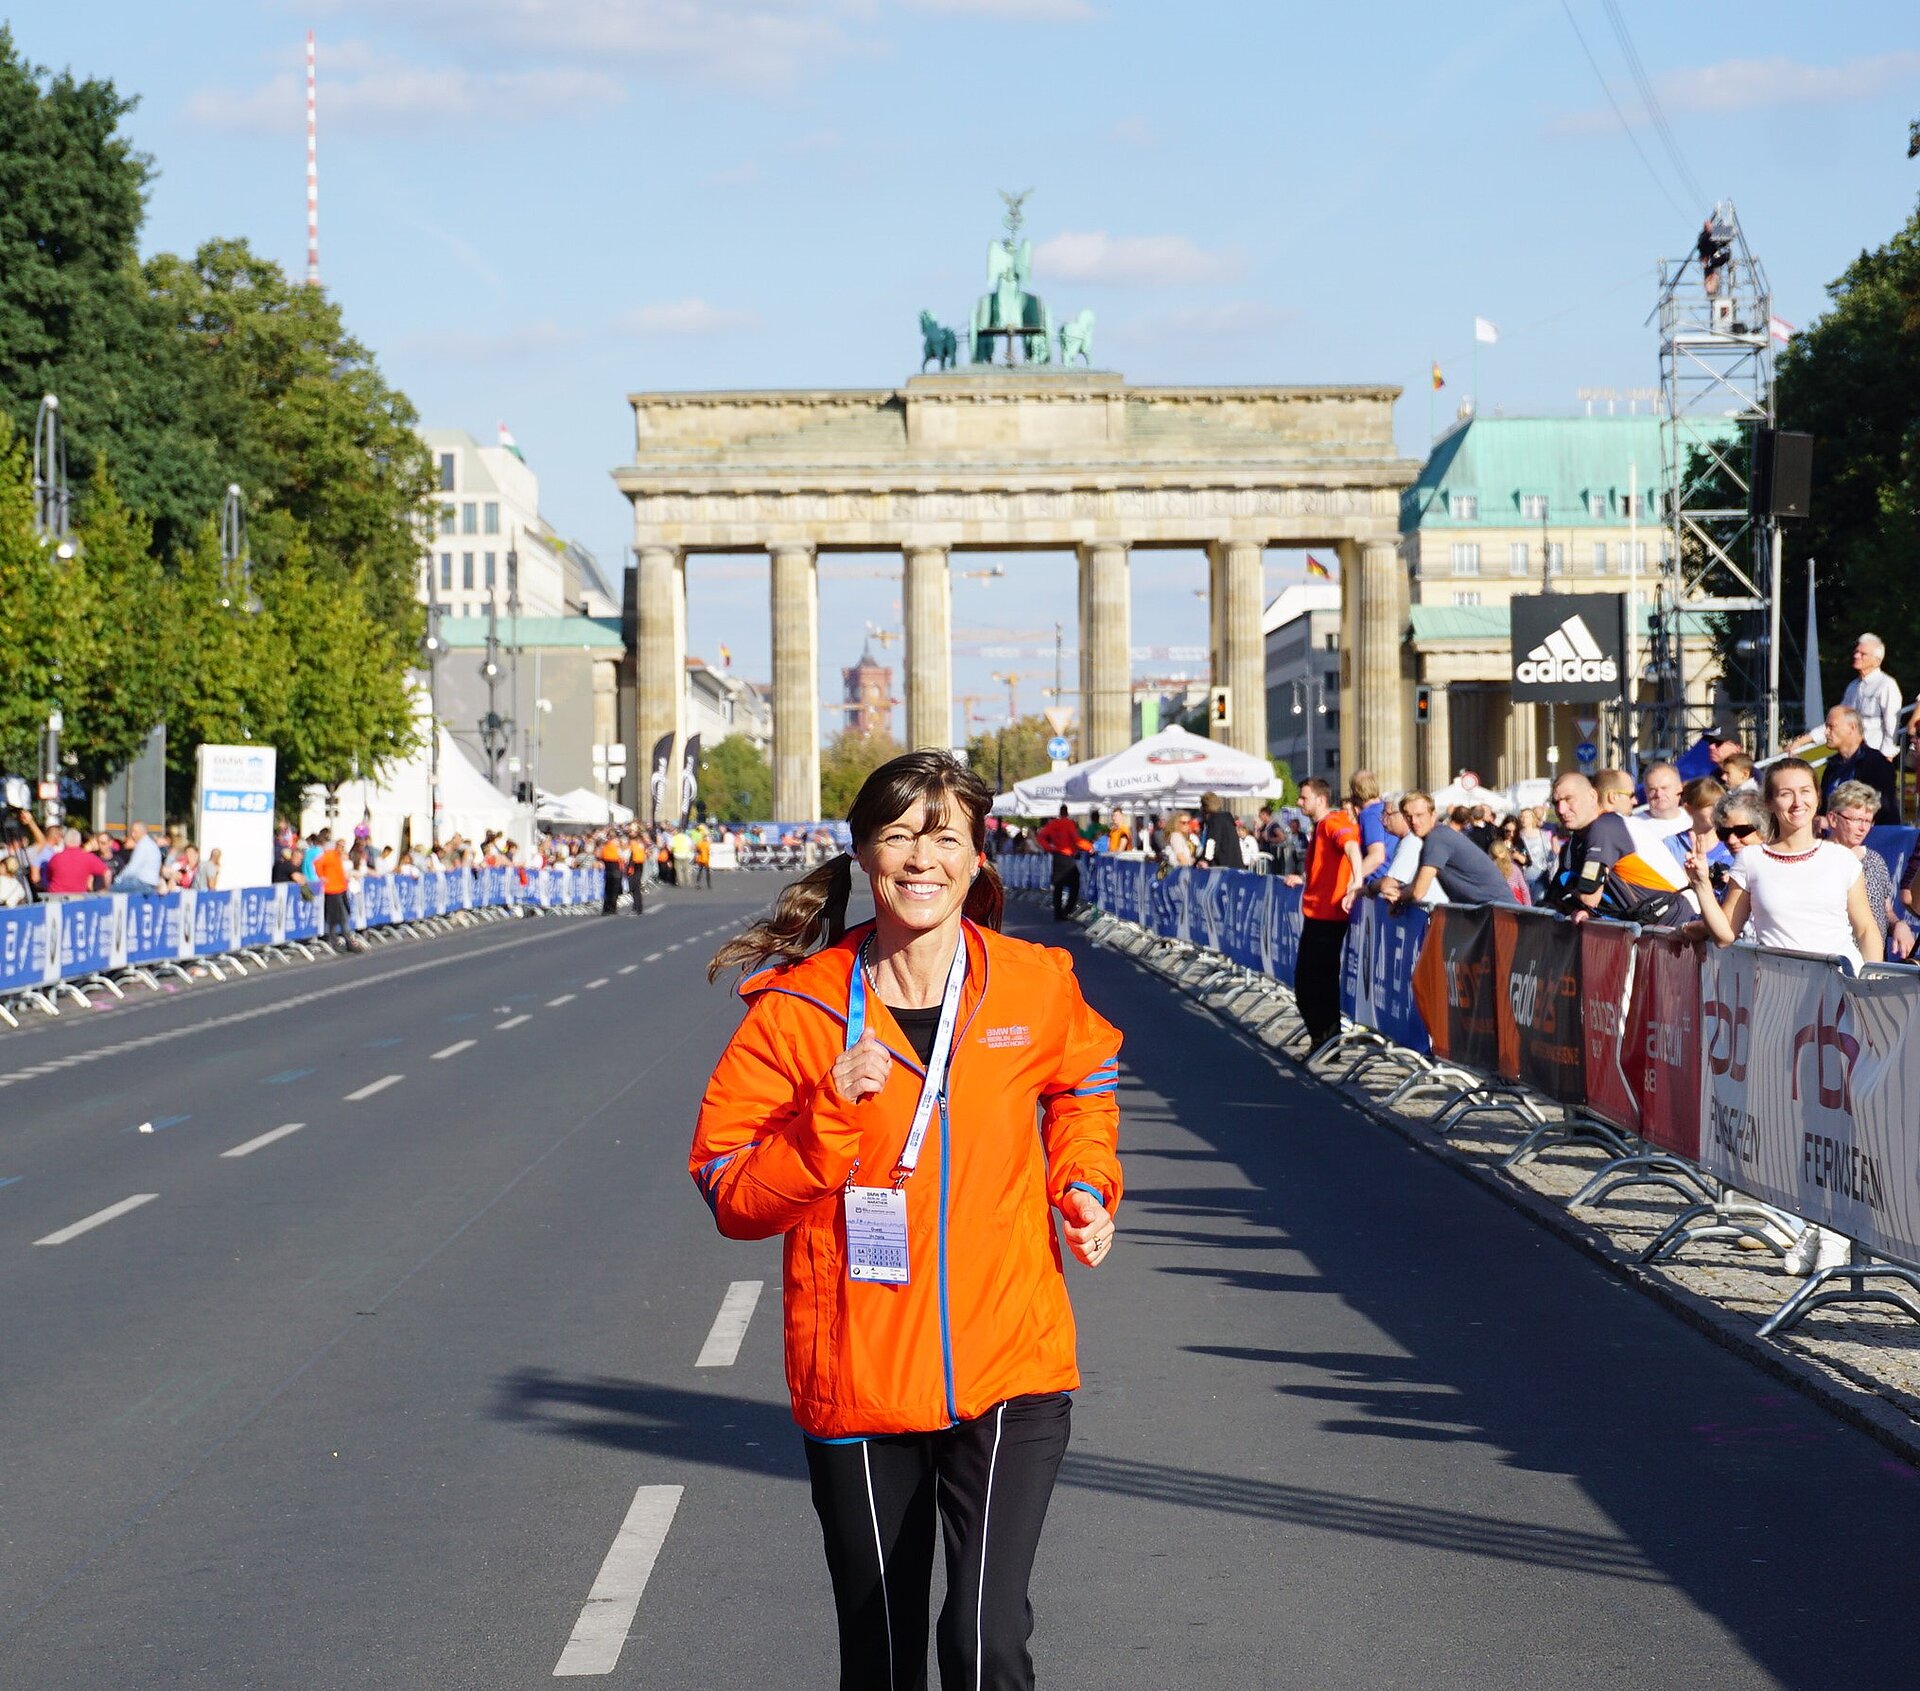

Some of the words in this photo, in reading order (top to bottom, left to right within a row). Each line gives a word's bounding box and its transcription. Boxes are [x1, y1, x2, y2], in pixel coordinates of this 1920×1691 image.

[1516, 656, 1617, 684] adidas
[1106, 773, 1161, 789] ERDINGER
[208, 792, 239, 811] km
[240, 793, 267, 812] 42
